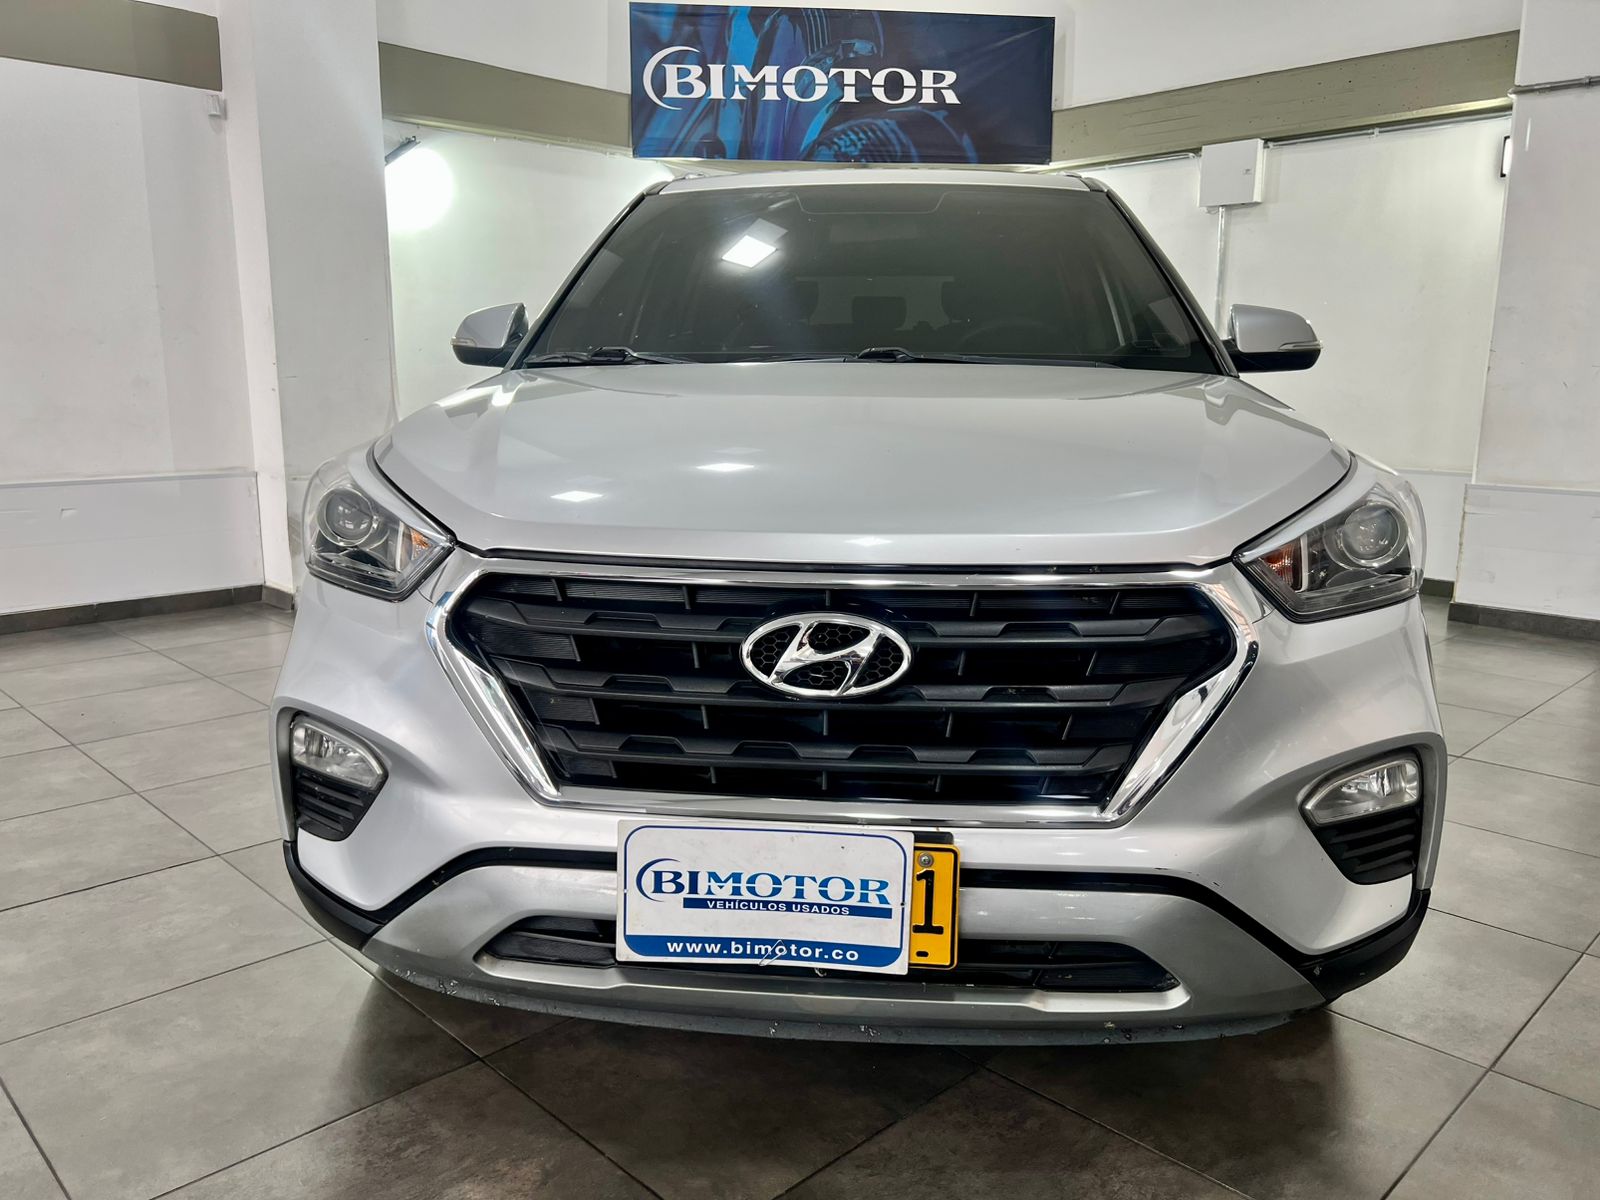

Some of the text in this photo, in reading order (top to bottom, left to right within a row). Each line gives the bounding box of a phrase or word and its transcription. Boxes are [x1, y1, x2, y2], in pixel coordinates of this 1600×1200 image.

[662, 63, 961, 105] BIMOTOR
[650, 870, 892, 906] BIMOTOR
[913, 870, 944, 934] 1
[706, 899, 850, 916] VEHÍCULOS USADOS
[667, 940, 860, 962] www.bimotor.co
